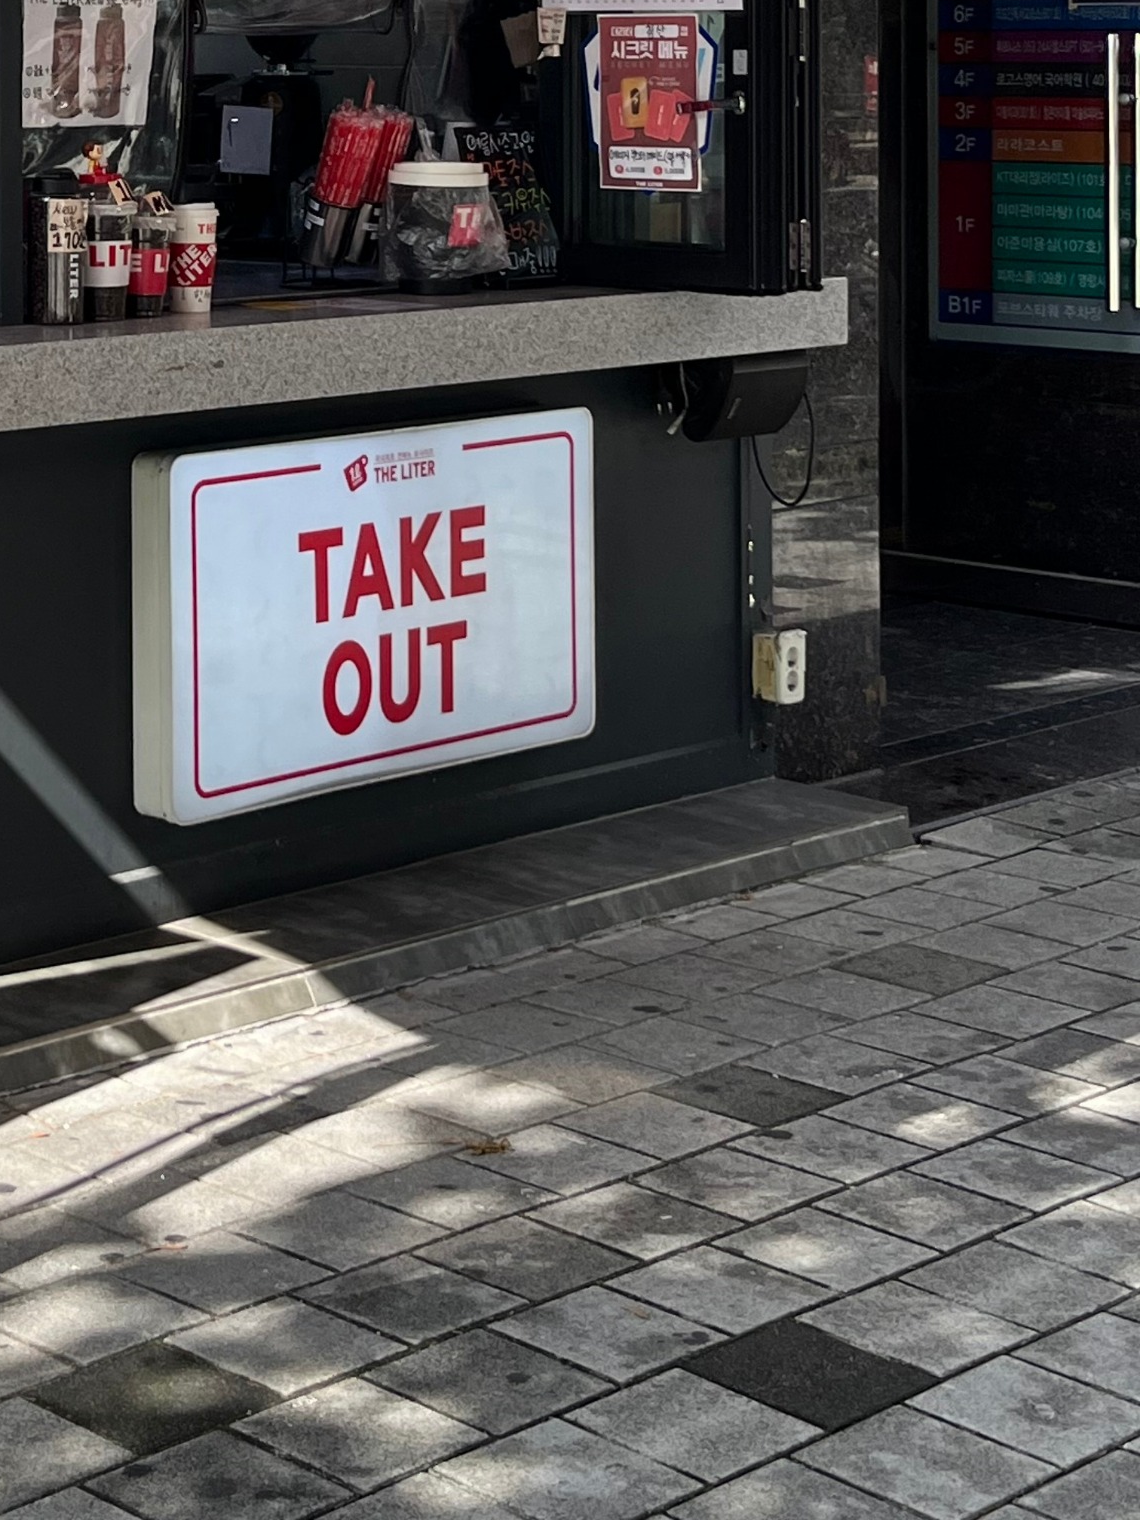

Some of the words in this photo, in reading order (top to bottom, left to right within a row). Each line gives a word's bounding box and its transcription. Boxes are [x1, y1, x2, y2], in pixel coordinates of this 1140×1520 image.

[953, 4, 975, 23] 6F
[611, 40, 654, 60] 시크릿
[657, 40, 689, 60] 메뉴
[954, 37, 975, 55] 5F
[954, 69, 976, 88] 4F
[954, 101, 976, 120] 3F
[954, 133, 977, 152] 2F
[955, 215, 976, 232] 1F
[947, 294, 982, 314] B1F
[373, 465, 398, 484] THE
[401, 460, 435, 480] LITER
[298, 504, 488, 624] TAKE
[322, 620, 468, 737] OUT
